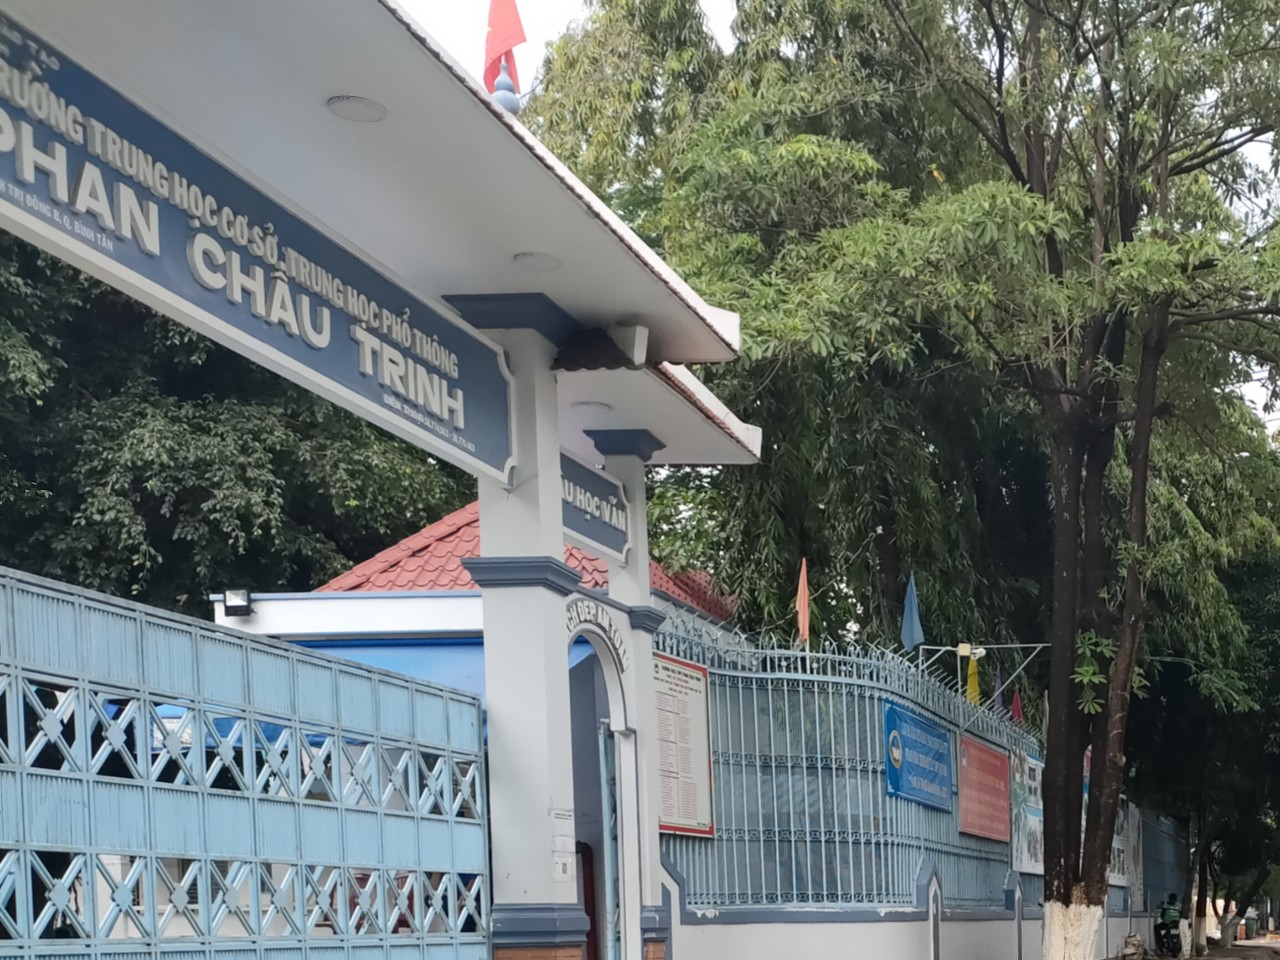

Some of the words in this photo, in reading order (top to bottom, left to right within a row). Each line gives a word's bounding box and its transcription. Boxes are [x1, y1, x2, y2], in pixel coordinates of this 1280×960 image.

[0, 57, 84, 145] RƯỜNG
[85, 117, 169, 199] TRUNG
[169, 171, 218, 228] HỌC
[217, 206, 248, 246] CƠ
[282, 246, 345, 309] TRUNG
[344, 284, 380, 329] HỌC
[379, 307, 412, 348] PHỔ
[411, 328, 459, 379] THÔNG
[187, 232, 332, 348] CHÂU
[349, 323, 465, 430] TRINH
[573, 485, 600, 520] HỌC
[600, 495, 627, 532] VĂN
